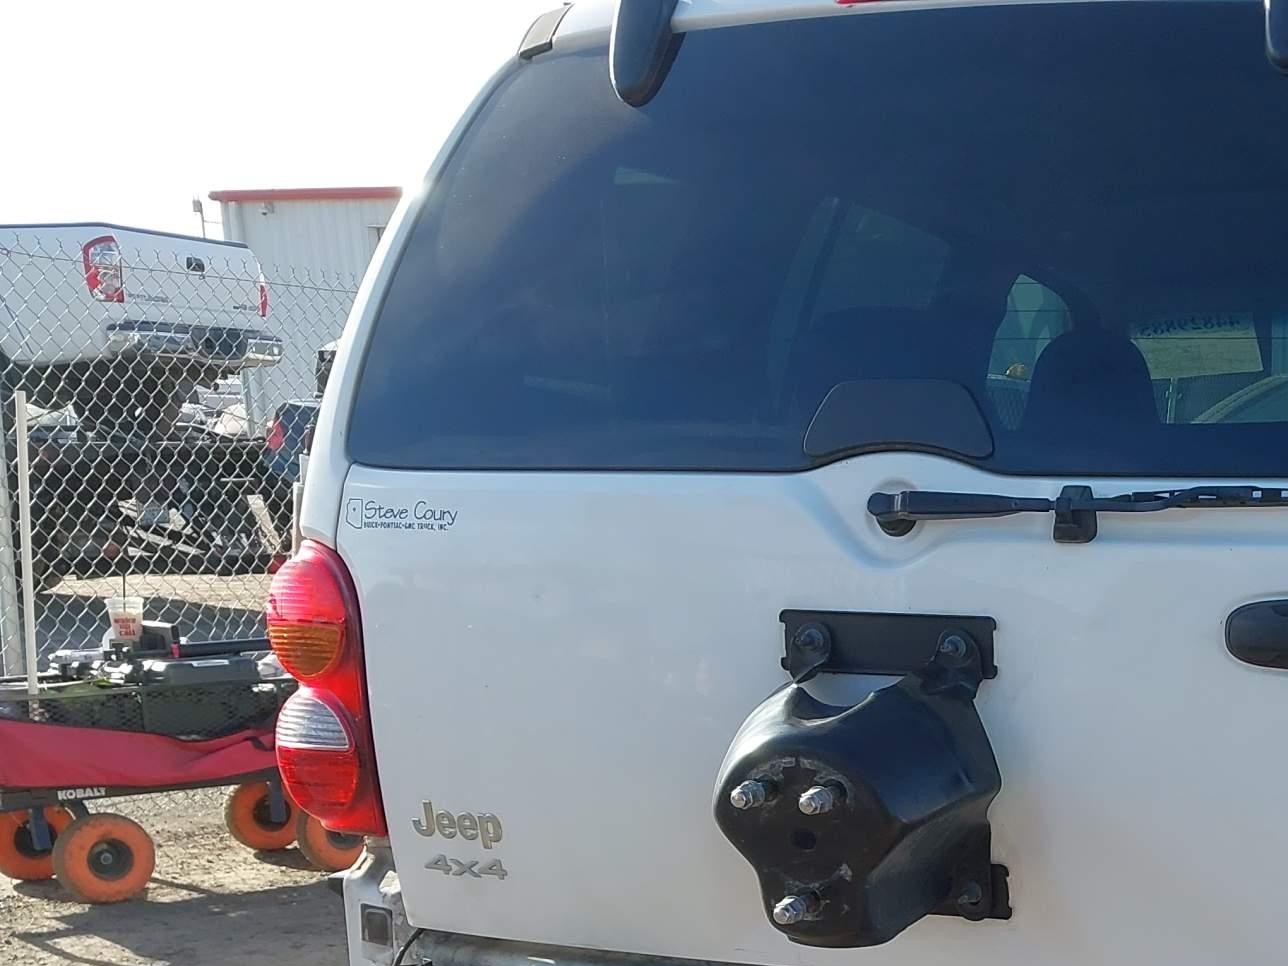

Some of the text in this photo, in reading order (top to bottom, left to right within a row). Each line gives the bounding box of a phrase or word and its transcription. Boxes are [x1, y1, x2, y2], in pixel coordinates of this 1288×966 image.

[365, 501, 458, 525] Steve Coury
[57, 786, 106, 801] KOBALT
[411, 799, 502, 850] Jeep
